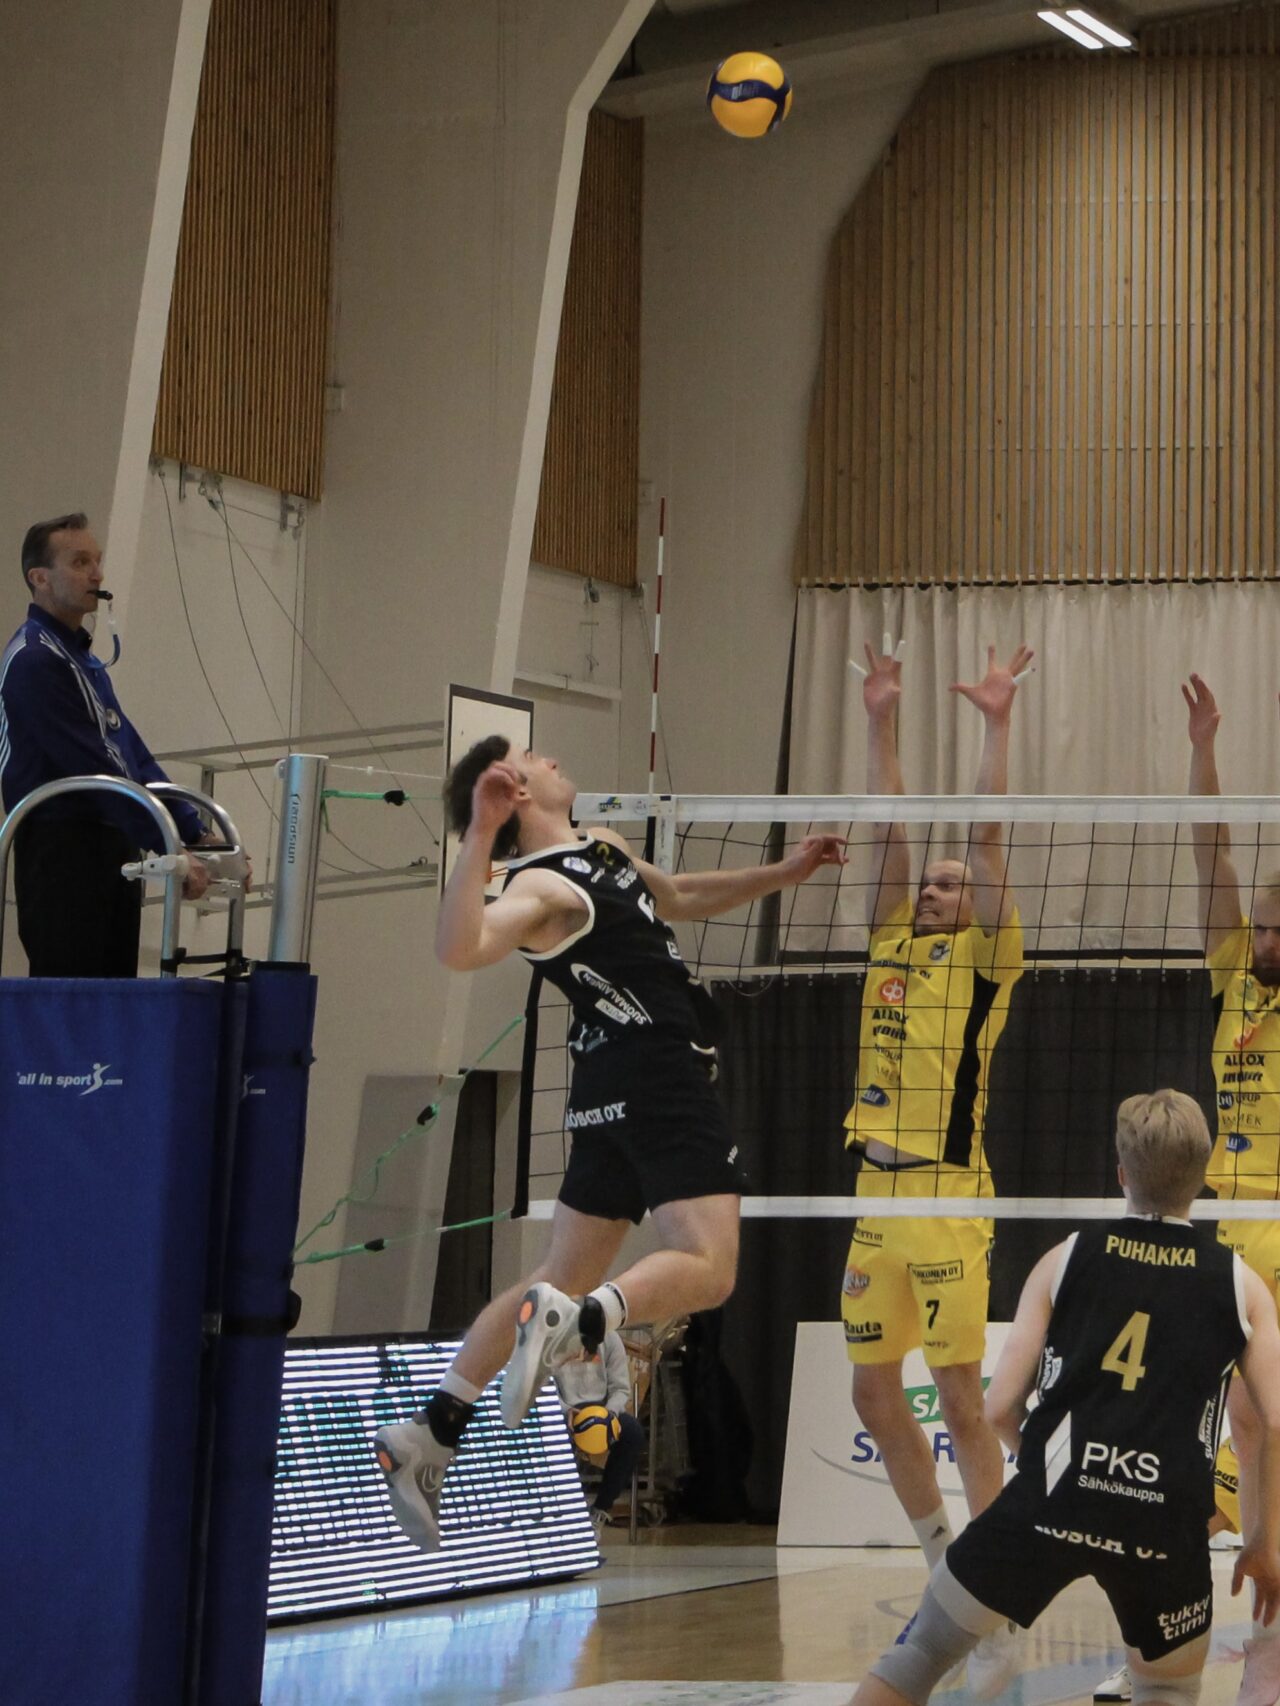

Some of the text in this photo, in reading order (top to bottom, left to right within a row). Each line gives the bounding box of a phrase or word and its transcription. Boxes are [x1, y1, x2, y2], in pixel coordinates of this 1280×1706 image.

[583, 972, 647, 1025] SUOMALAINEN
[1224, 1054, 1265, 1067] ALLOX
[39, 1073, 52, 1085] in
[56, 1074, 92, 1088] sport
[1105, 1234, 1196, 1267] PUHAKKA
[844, 1319, 882, 1335] Rauta
[925, 1299, 940, 1330] 7
[1101, 1310, 1150, 1391] 4
[1081, 1441, 1161, 1483] PKS
[1078, 1474, 1165, 1503] Sähkökauppa
